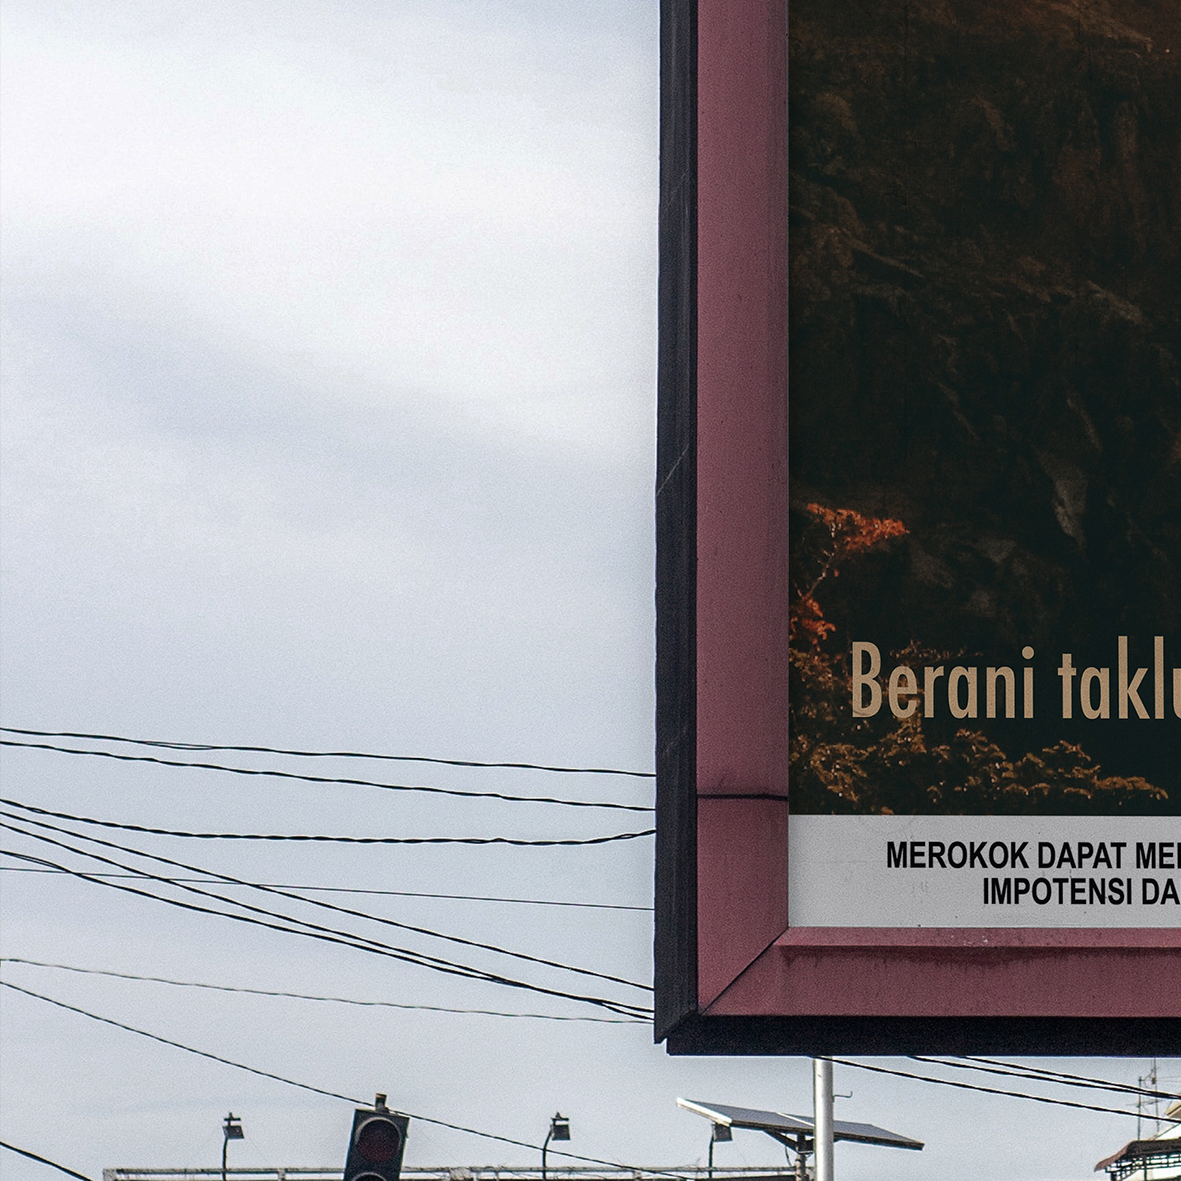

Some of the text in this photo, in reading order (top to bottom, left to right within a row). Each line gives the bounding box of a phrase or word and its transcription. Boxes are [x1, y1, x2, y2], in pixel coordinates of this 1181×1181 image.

[851, 641, 1036, 720] Berani
[887, 841, 1028, 869] MEROKOK
[1038, 842, 1126, 870] DAPAT
[983, 878, 1132, 906] IMPOTENSI
